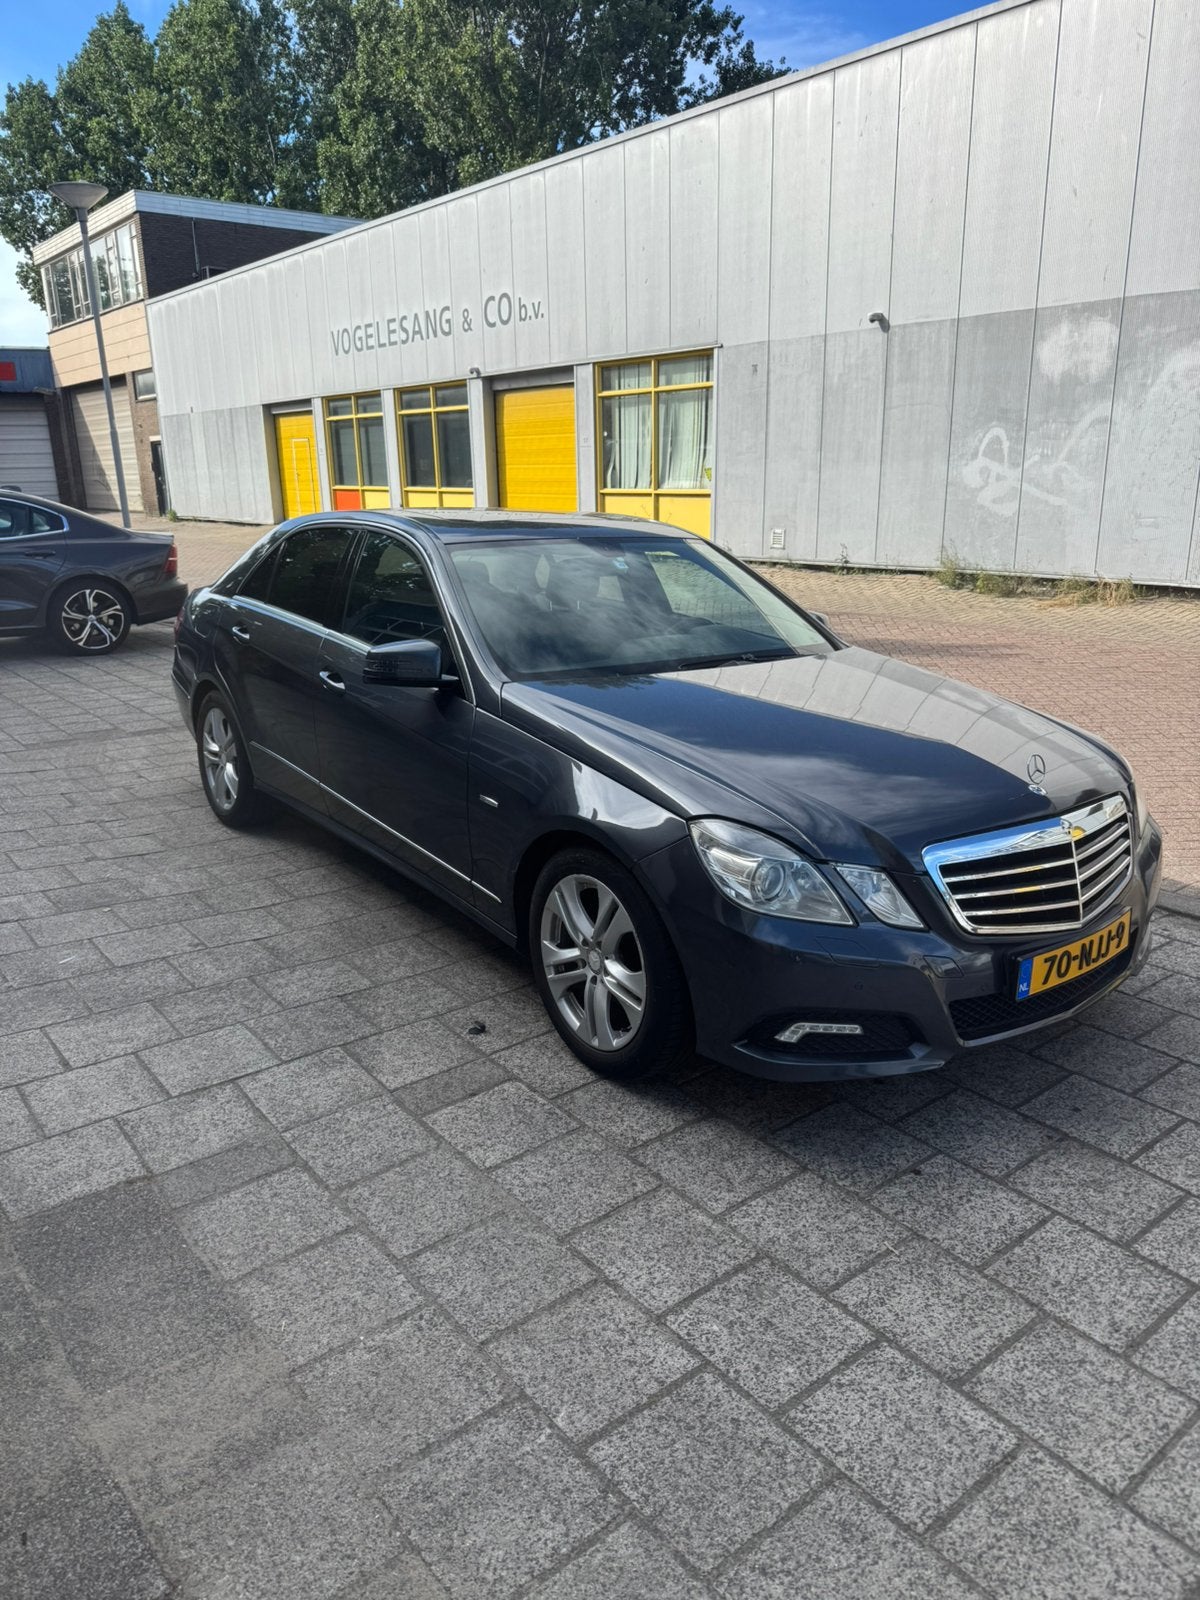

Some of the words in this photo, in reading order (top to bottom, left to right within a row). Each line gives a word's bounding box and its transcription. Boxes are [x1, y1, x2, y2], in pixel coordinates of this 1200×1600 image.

[331, 306, 451, 356] VOGELESANG
[462, 308, 473, 333] &
[484, 292, 512, 328] CO
[518, 297, 545, 322] b.v.
[1042, 921, 1125, 985] 70-NJJ-9
[1018, 982, 1029, 992] NL
